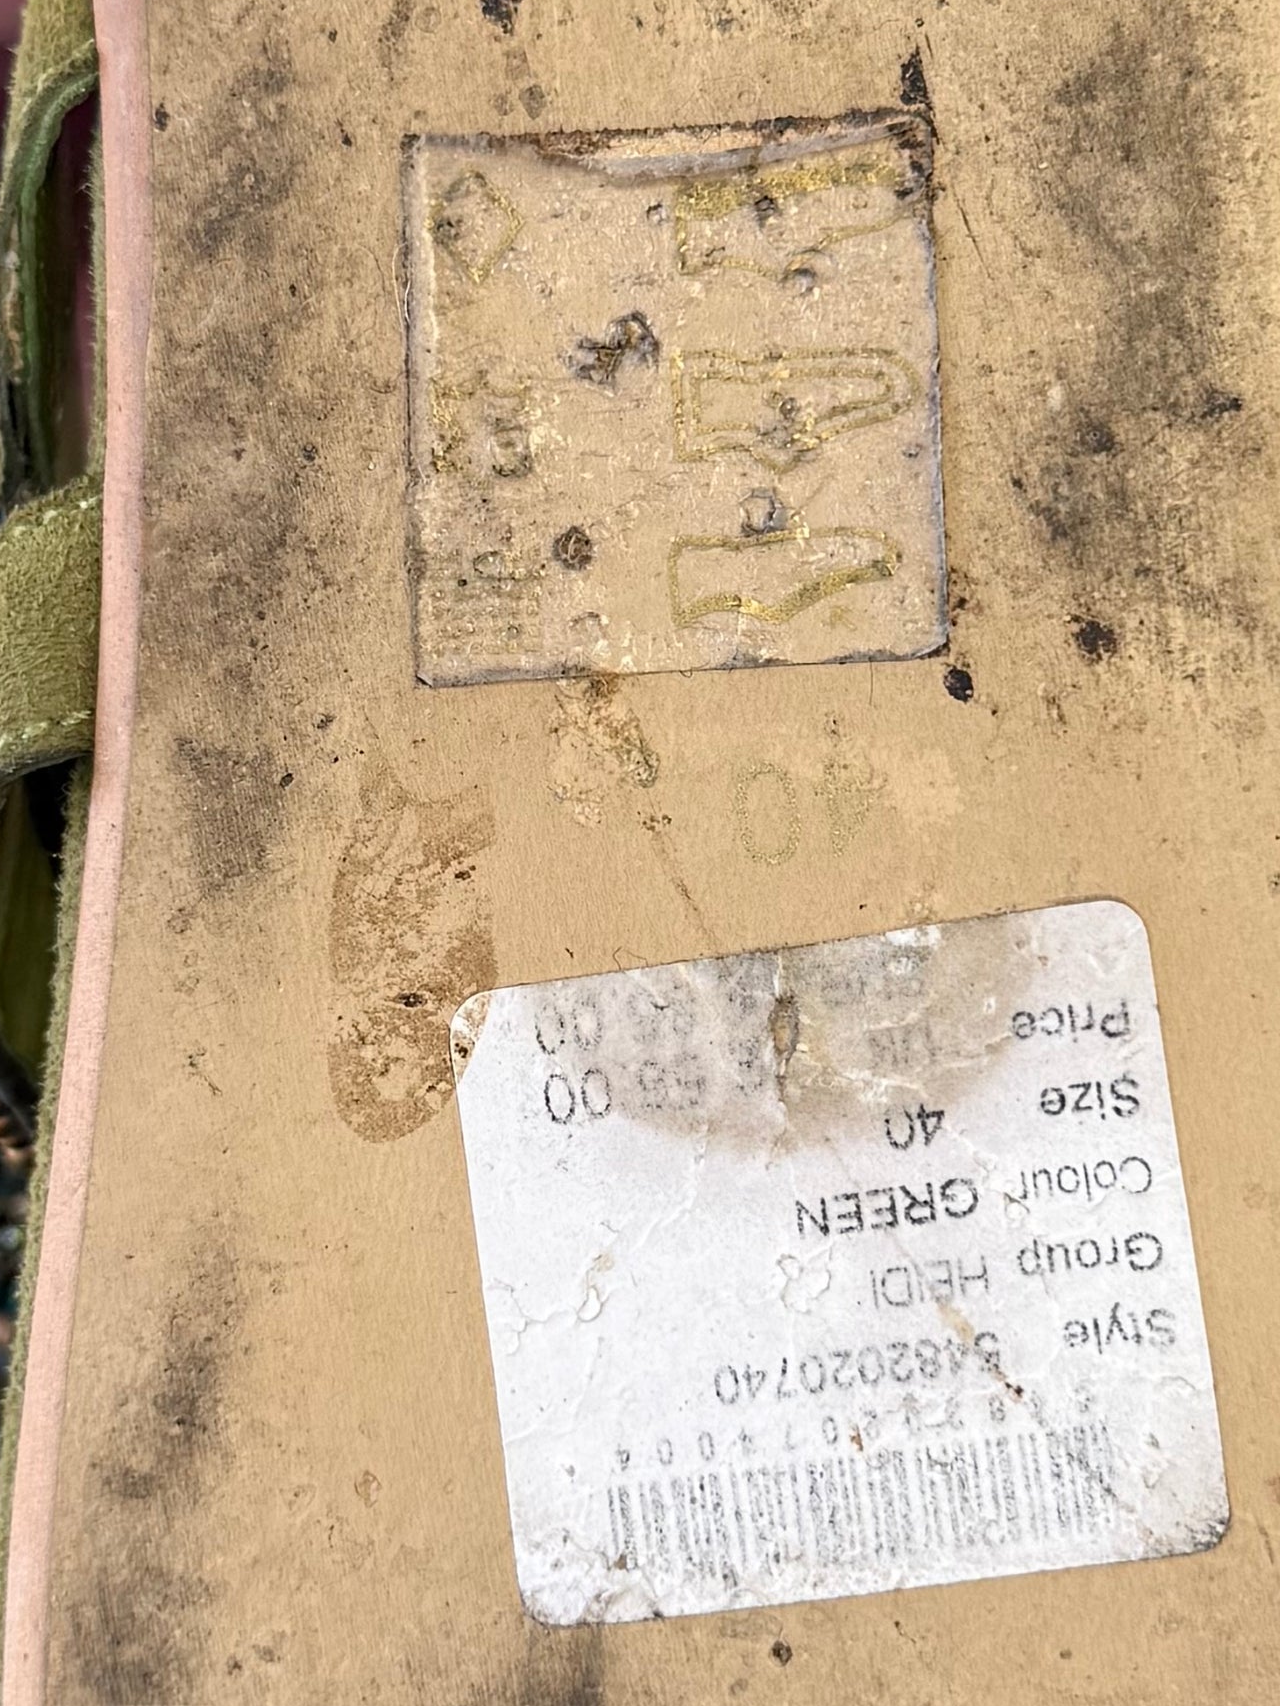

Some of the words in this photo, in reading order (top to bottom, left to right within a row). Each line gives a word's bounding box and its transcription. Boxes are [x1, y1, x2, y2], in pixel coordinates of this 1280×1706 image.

[737, 761, 888, 866] 40
[1011, 1000, 1131, 1041] Price
[1041, 1071, 1139, 1118] Size
[885, 1104, 946, 1151] 40
[1019, 1156, 1153, 1200] Colour
[797, 1177, 979, 1238] GREEN
[1016, 1232, 1163, 1276] Group
[870, 1256, 990, 1310] HEIDI
[1063, 1302, 1177, 1354] Style
[715, 1332, 1001, 1406] 5482020740
